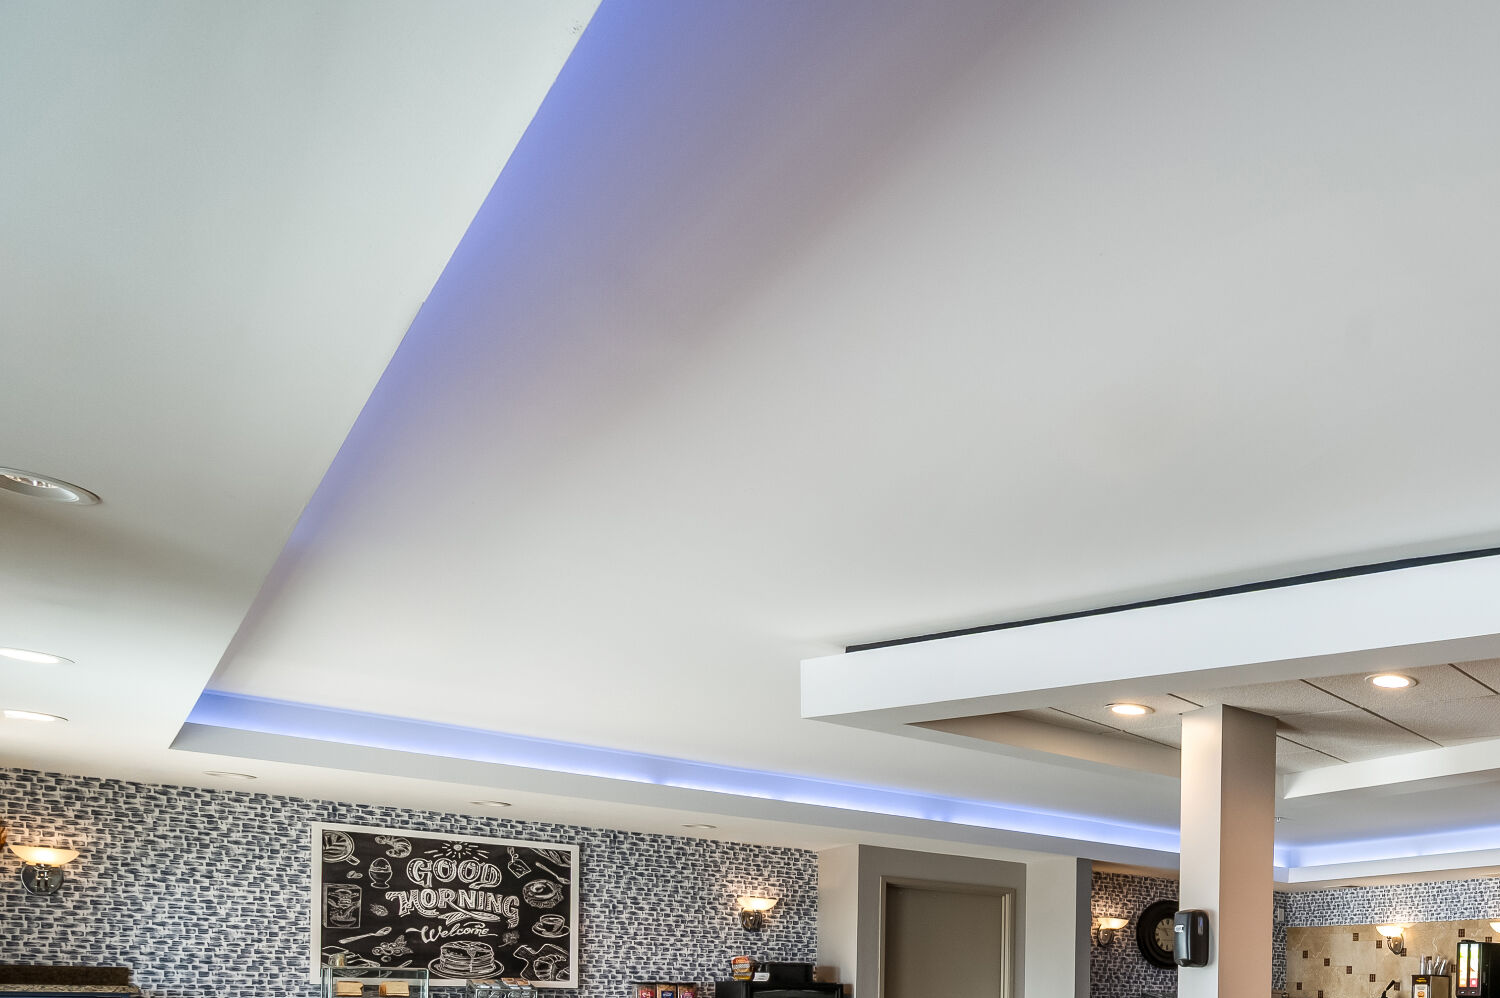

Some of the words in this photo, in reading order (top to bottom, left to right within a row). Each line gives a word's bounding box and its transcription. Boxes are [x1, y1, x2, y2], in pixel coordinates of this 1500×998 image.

[406, 858, 502, 889] GOOD
[385, 889, 520, 928] MORNING
[406, 921, 498, 944] Welcome
